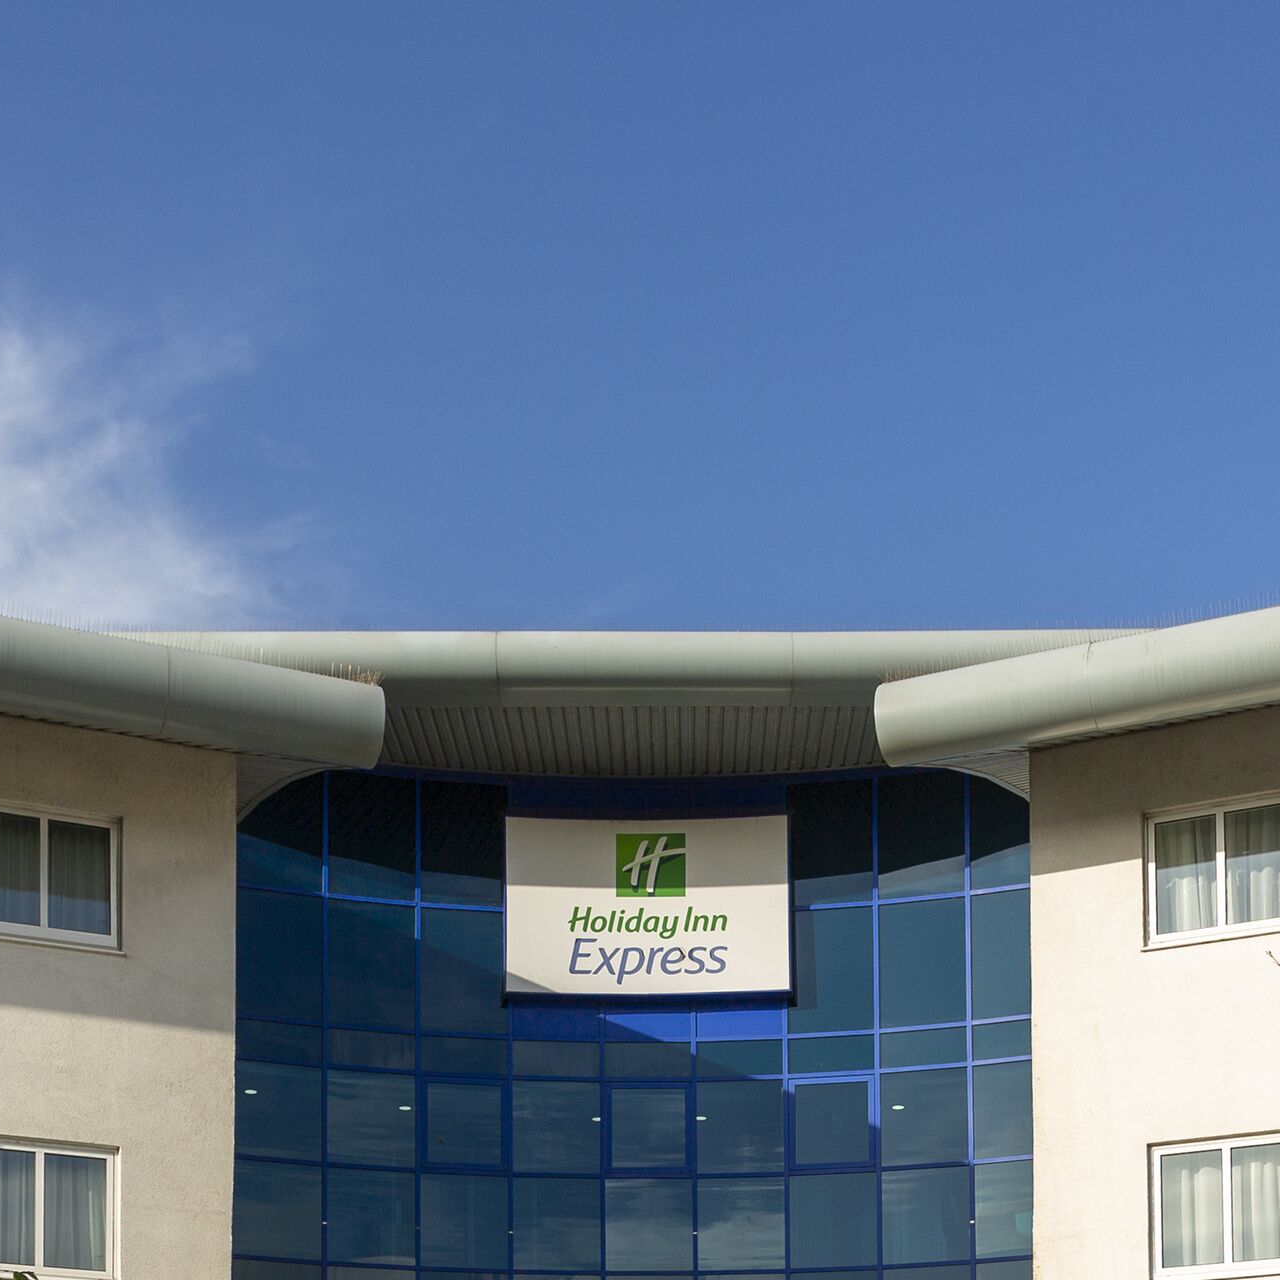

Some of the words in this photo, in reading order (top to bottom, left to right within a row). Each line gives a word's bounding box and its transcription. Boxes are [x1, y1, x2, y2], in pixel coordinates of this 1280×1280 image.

[622, 836, 686, 894] H
[568, 906, 679, 939] Holiday
[684, 906, 728, 932] Inn
[569, 938, 729, 985] Express
